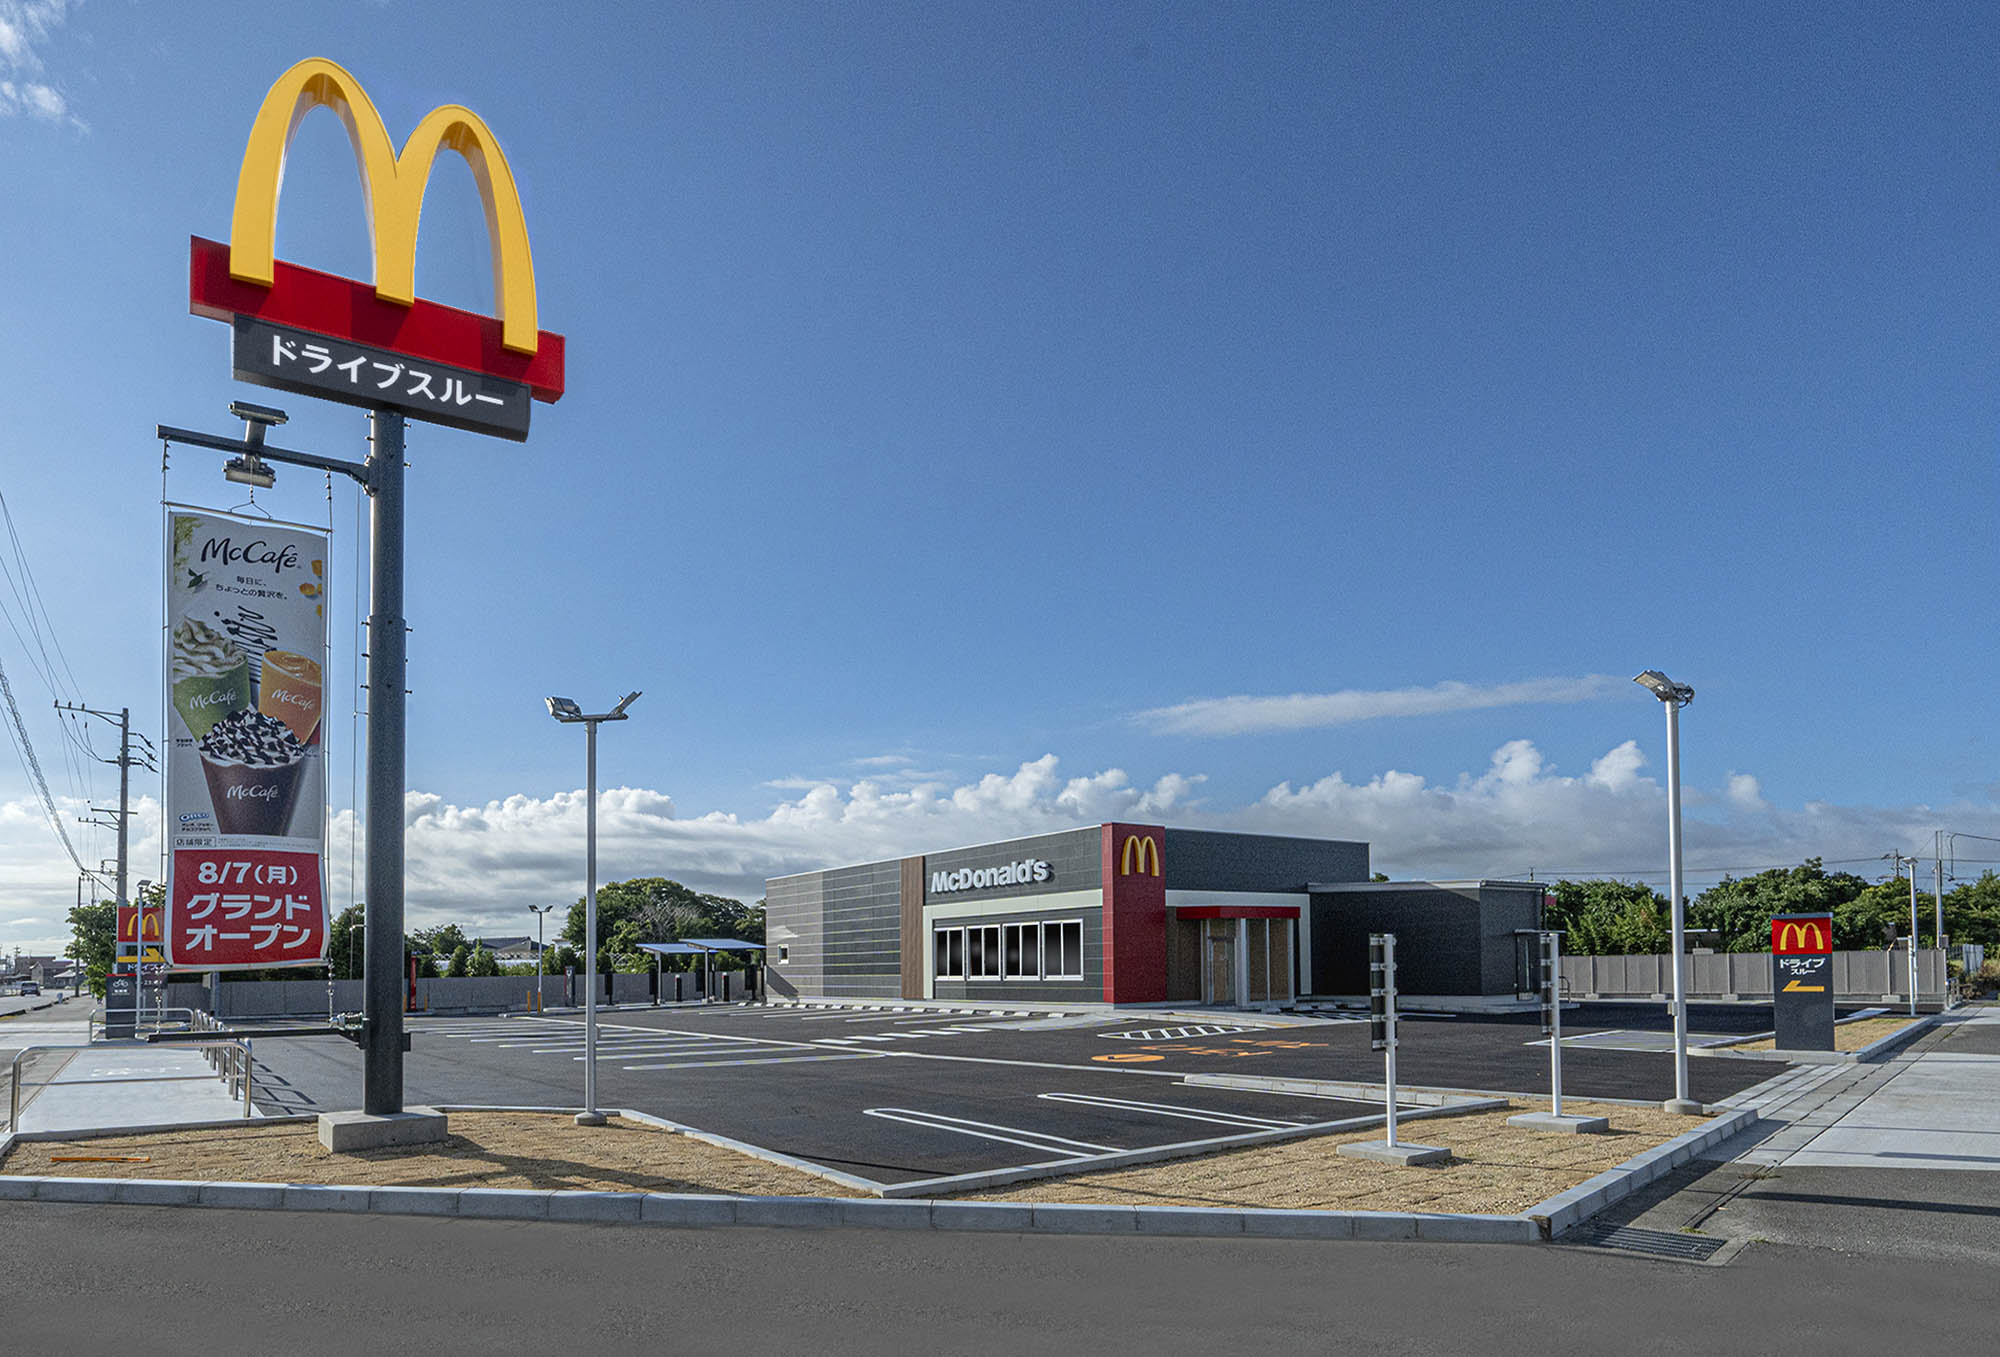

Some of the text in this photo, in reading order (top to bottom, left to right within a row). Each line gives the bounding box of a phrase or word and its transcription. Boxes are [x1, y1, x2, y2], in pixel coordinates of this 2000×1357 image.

[272, 335, 504, 407] ドライブスルー
[201, 537, 299, 574] McCafé
[931, 859, 1050, 893] McDonald's
[186, 892, 311, 920] グランド
[185, 922, 311, 951] オープン
[1779, 957, 1826, 969] ドライブ
